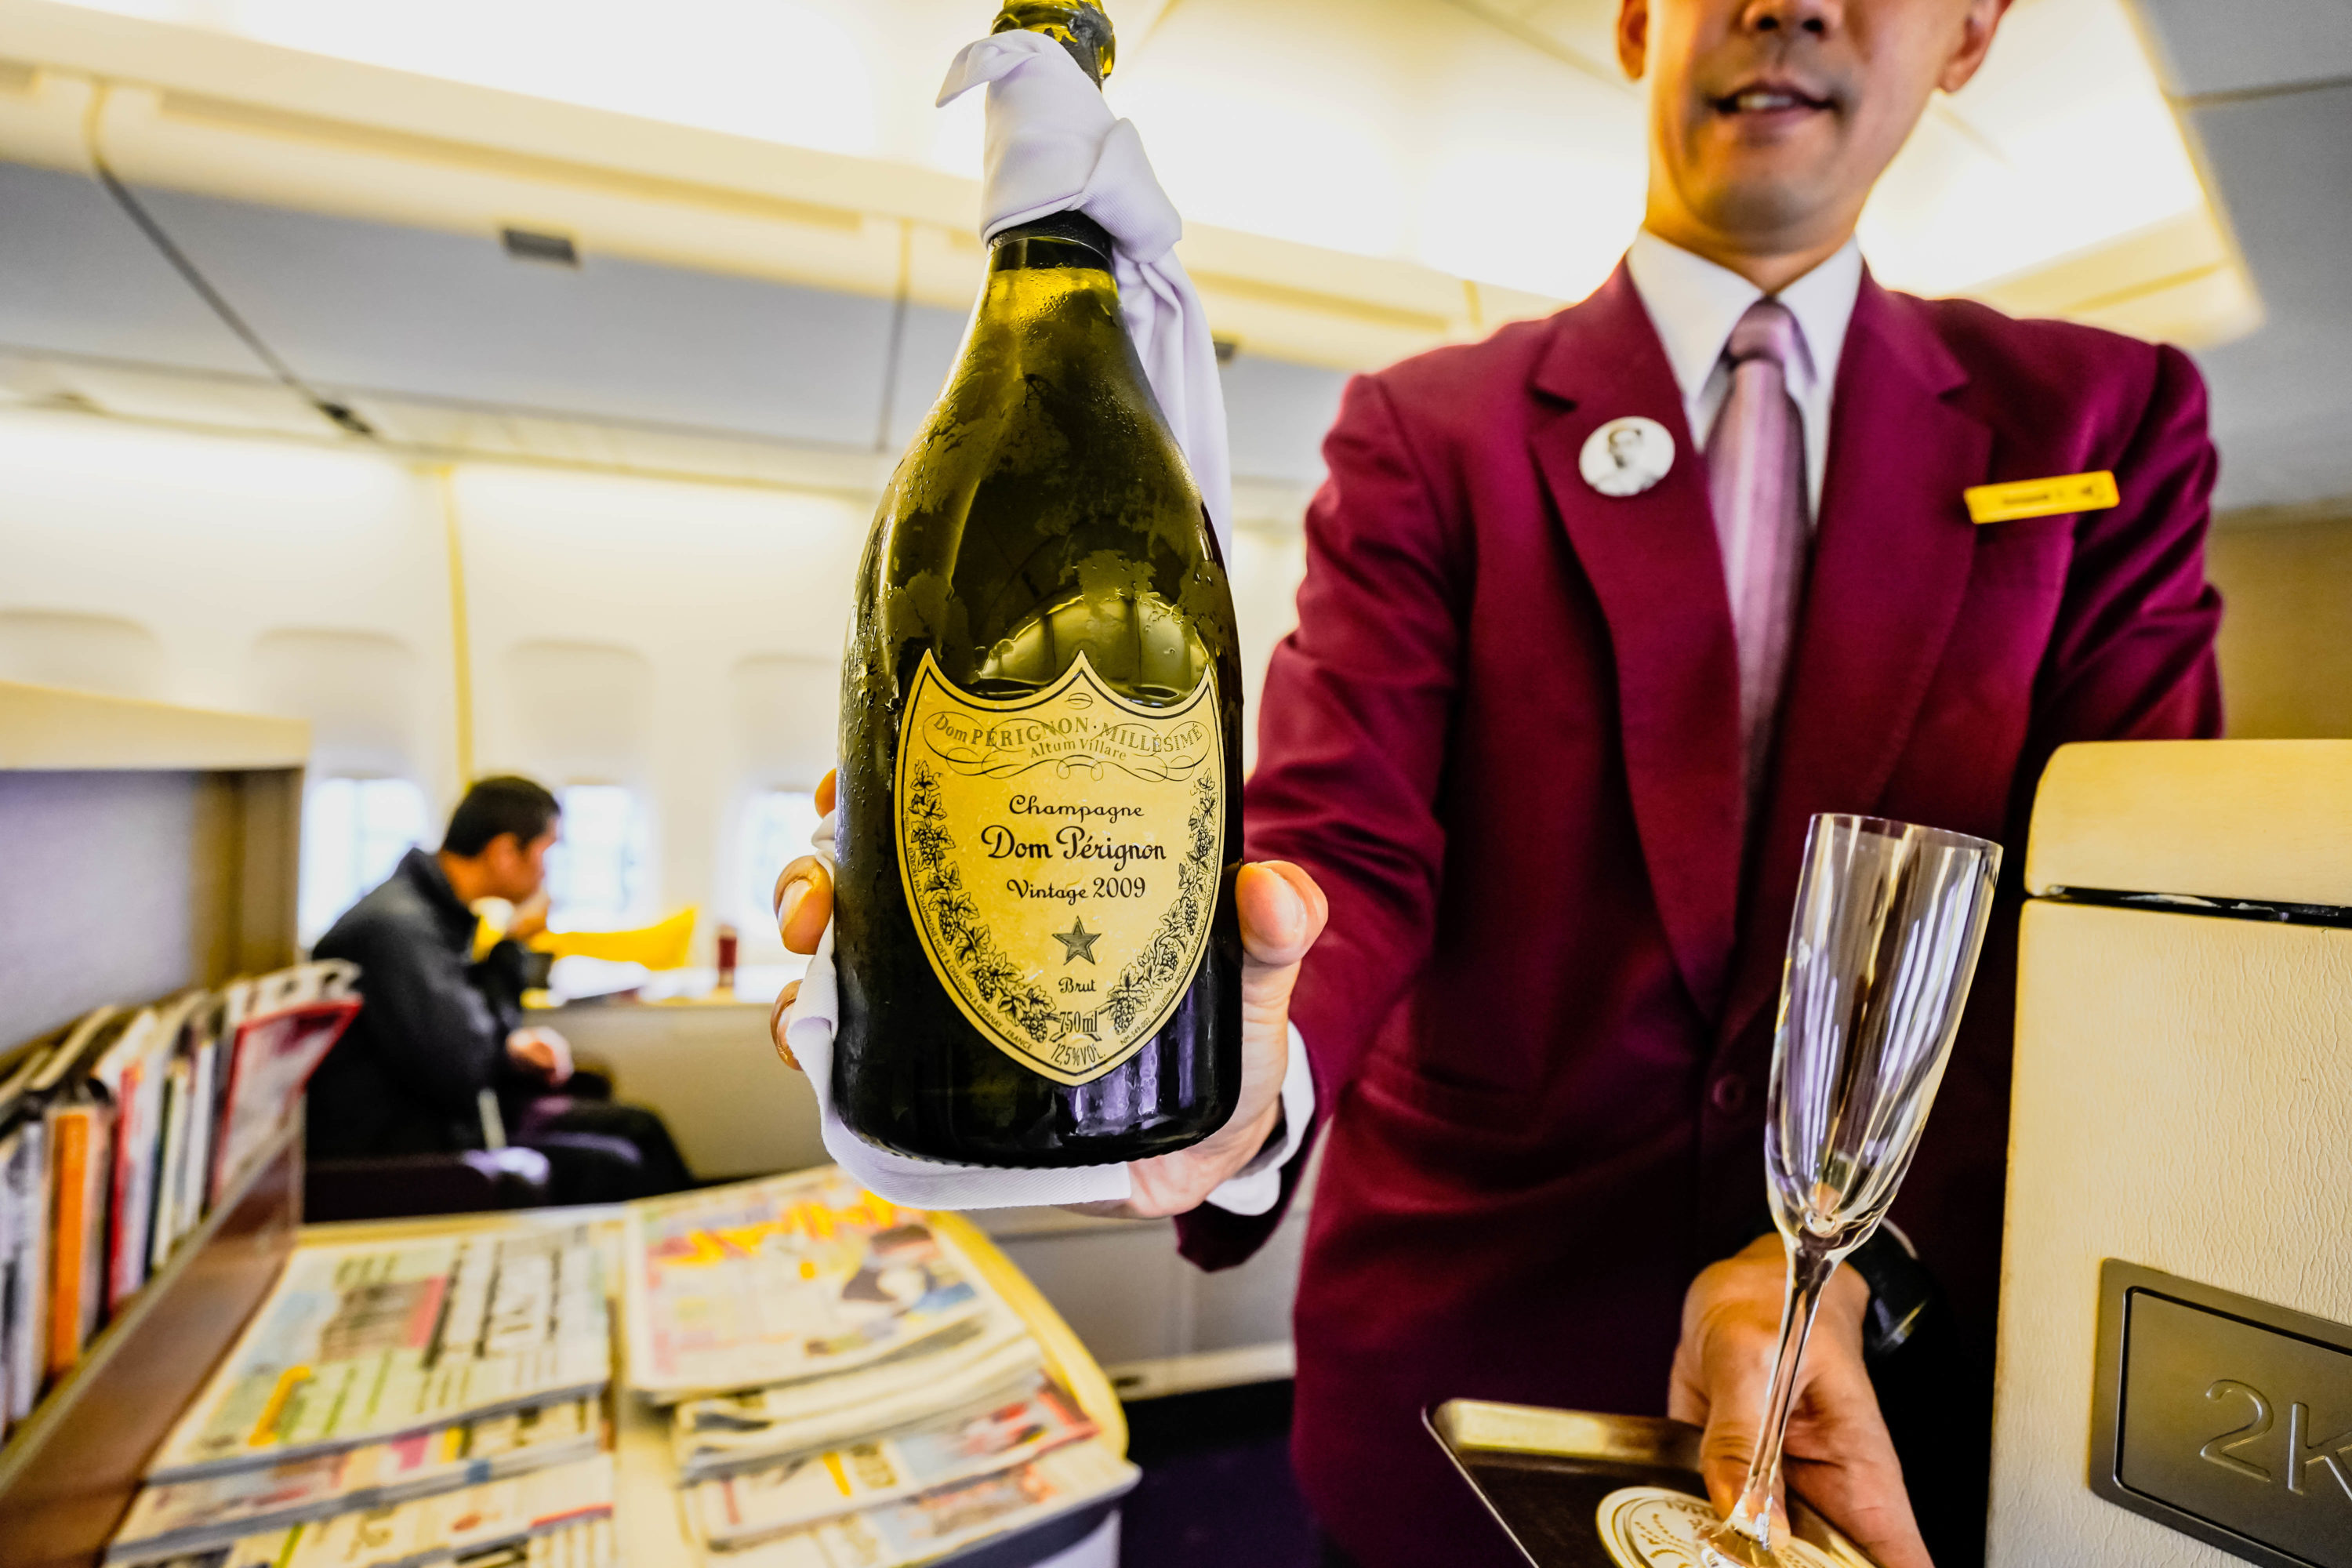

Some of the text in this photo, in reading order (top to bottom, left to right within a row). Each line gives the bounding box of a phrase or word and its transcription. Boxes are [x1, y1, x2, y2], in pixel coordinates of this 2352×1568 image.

[934, 714, 967, 743] Dom
[1030, 738, 1127, 760] Altum Villare
[1009, 794, 1145, 823] Champagne
[981, 825, 1167, 872] Dom Pérignon
[1007, 877, 1145, 906] Vintage 2009
[1175, 955, 1193, 984] PRODUCT
[1194, 919, 1205, 945] FRANCE
[1203, 886, 1213, 913] PRODUIT
[1058, 977, 1097, 994] Brut
[949, 965, 975, 1000] CHANDON
[1005, 1029, 1033, 1051] FRANCE
[1059, 1010, 1098, 1033] 750ml
[2199, 1378, 2352, 1501] 2K
